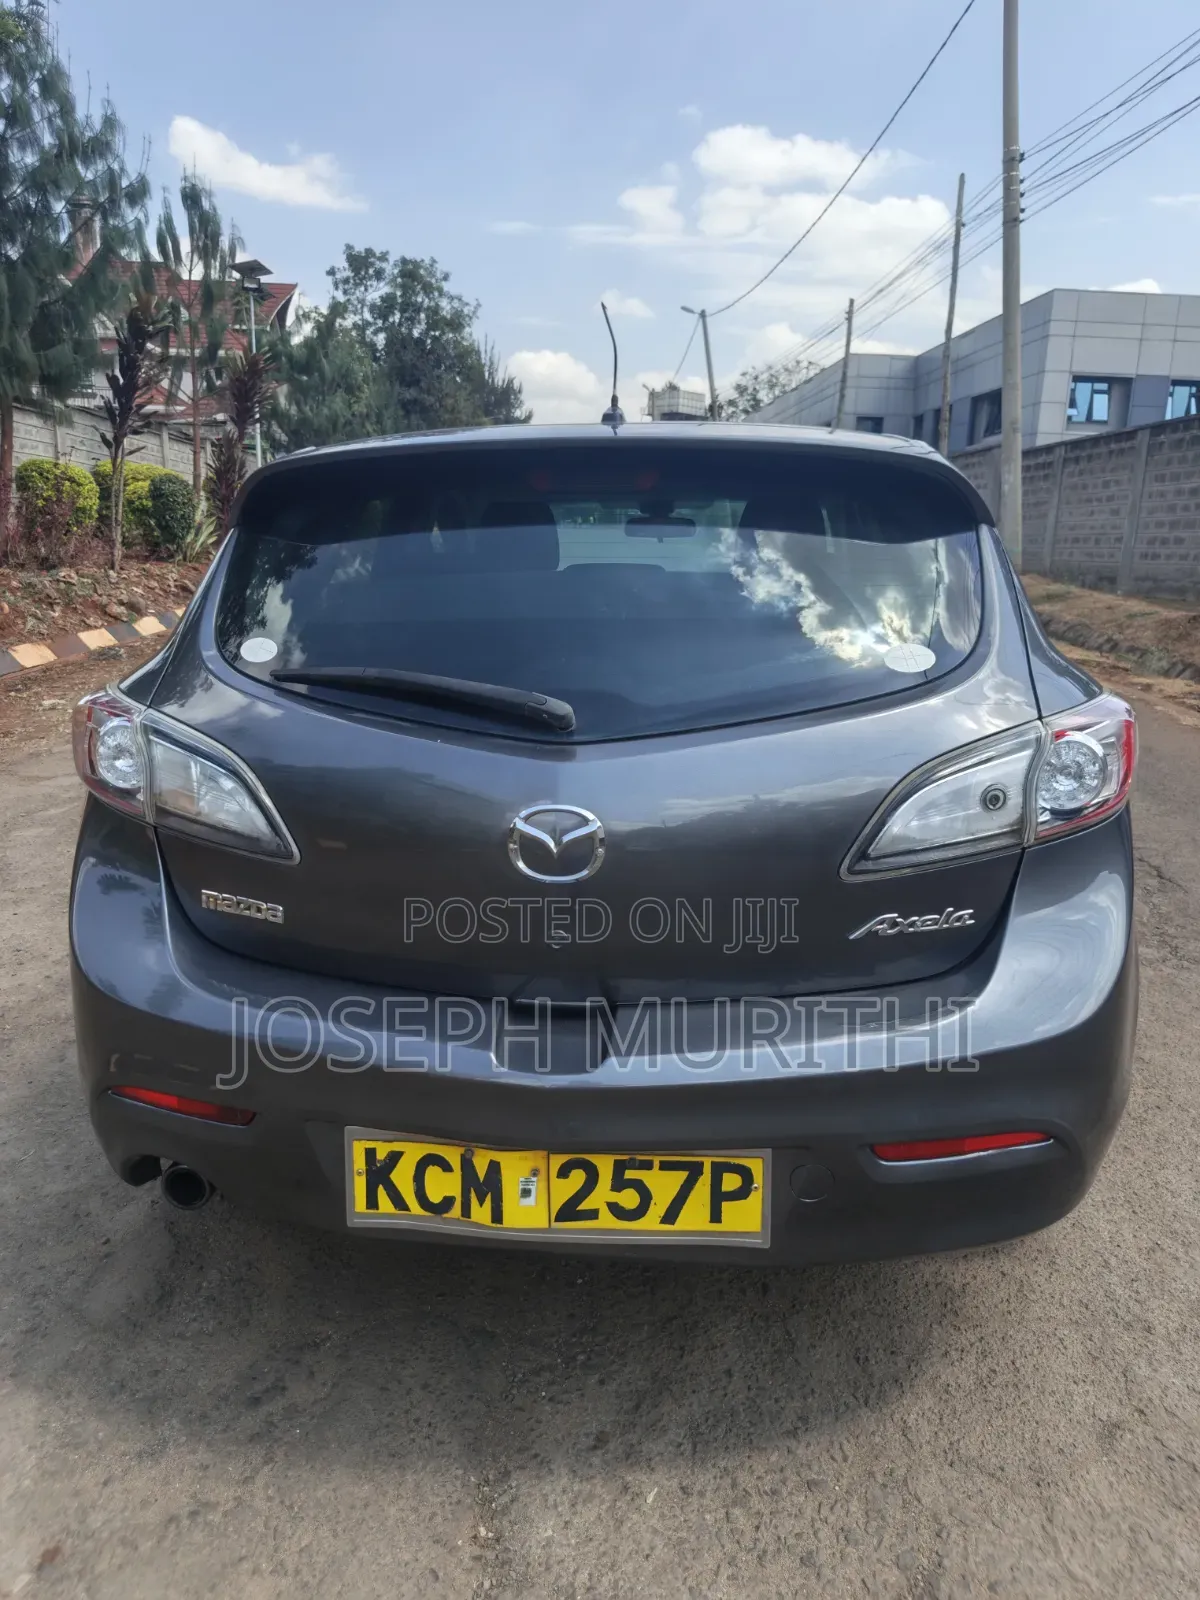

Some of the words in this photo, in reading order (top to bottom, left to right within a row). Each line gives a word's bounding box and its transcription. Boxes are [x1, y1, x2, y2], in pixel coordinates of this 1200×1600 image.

[201, 889, 285, 924] mazda
[848, 907, 976, 940] Axela
[364, 1147, 504, 1225] KCM
[554, 1157, 756, 1226] 257P
